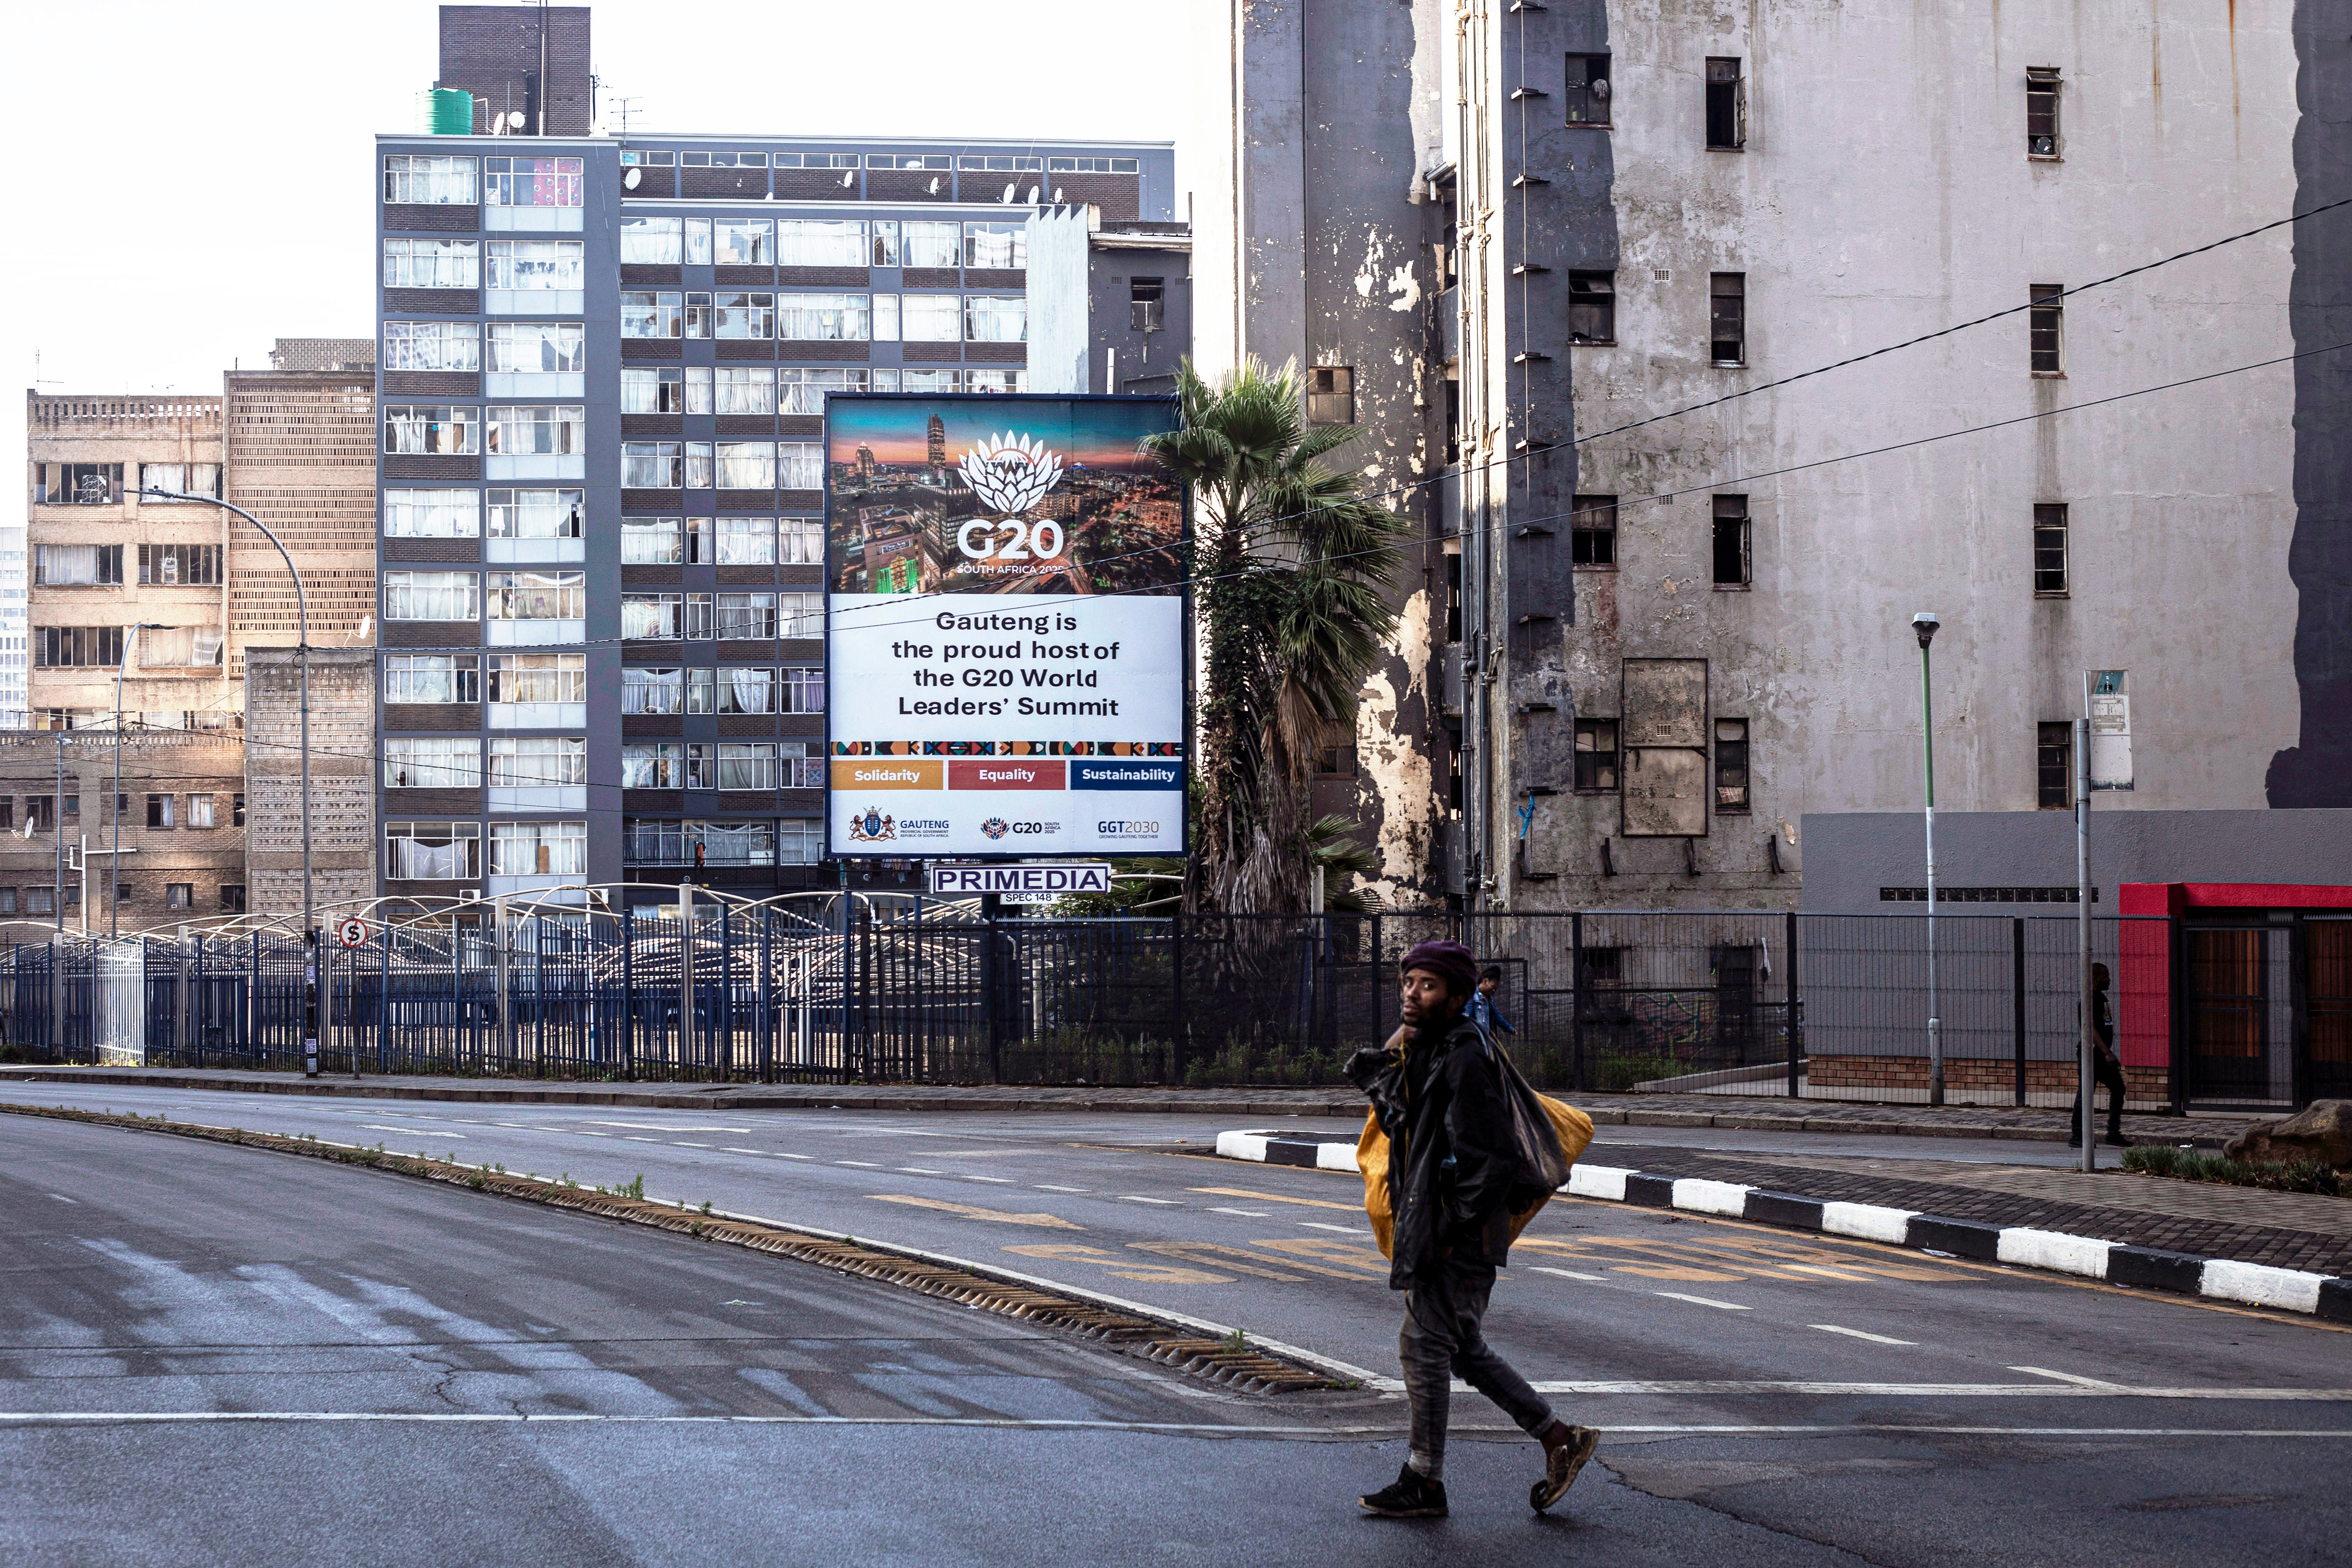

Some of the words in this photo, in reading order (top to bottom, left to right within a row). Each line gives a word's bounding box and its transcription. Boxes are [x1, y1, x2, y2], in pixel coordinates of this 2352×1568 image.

[957, 518, 1064, 560] G20
[957, 565, 994, 574] SOUTH
[997, 565, 1037, 574] AFRICA
[1039, 565, 1064, 574] 2025
[936, 612, 1049, 635] Gauteng
[1056, 612, 1077, 631] is
[892, 640, 933, 659] the
[944, 640, 1021, 663] proud
[1032, 640, 1089, 660] host
[1094, 641, 1120, 660] of
[913, 669, 954, 687] the
[962, 669, 1014, 687] G20
[1020, 669, 1097, 688] World
[899, 696, 1009, 716] Leaders’
[1017, 696, 1119, 716] Summit
[854, 769, 921, 783] Solidarity
[979, 768, 1035, 782] Equality
[1082, 769, 1175, 782] Sustainability
[900, 820, 949, 828] GAUTENG
[1012, 822, 1042, 834] G20
[1098, 821, 1159, 833] GGT2030
[938, 870, 1103, 890] PRIMEDIA
[1006, 893, 1032, 902] SPEC
[1035, 893, 1052, 901] 148
[348, 925, 360, 941] S
